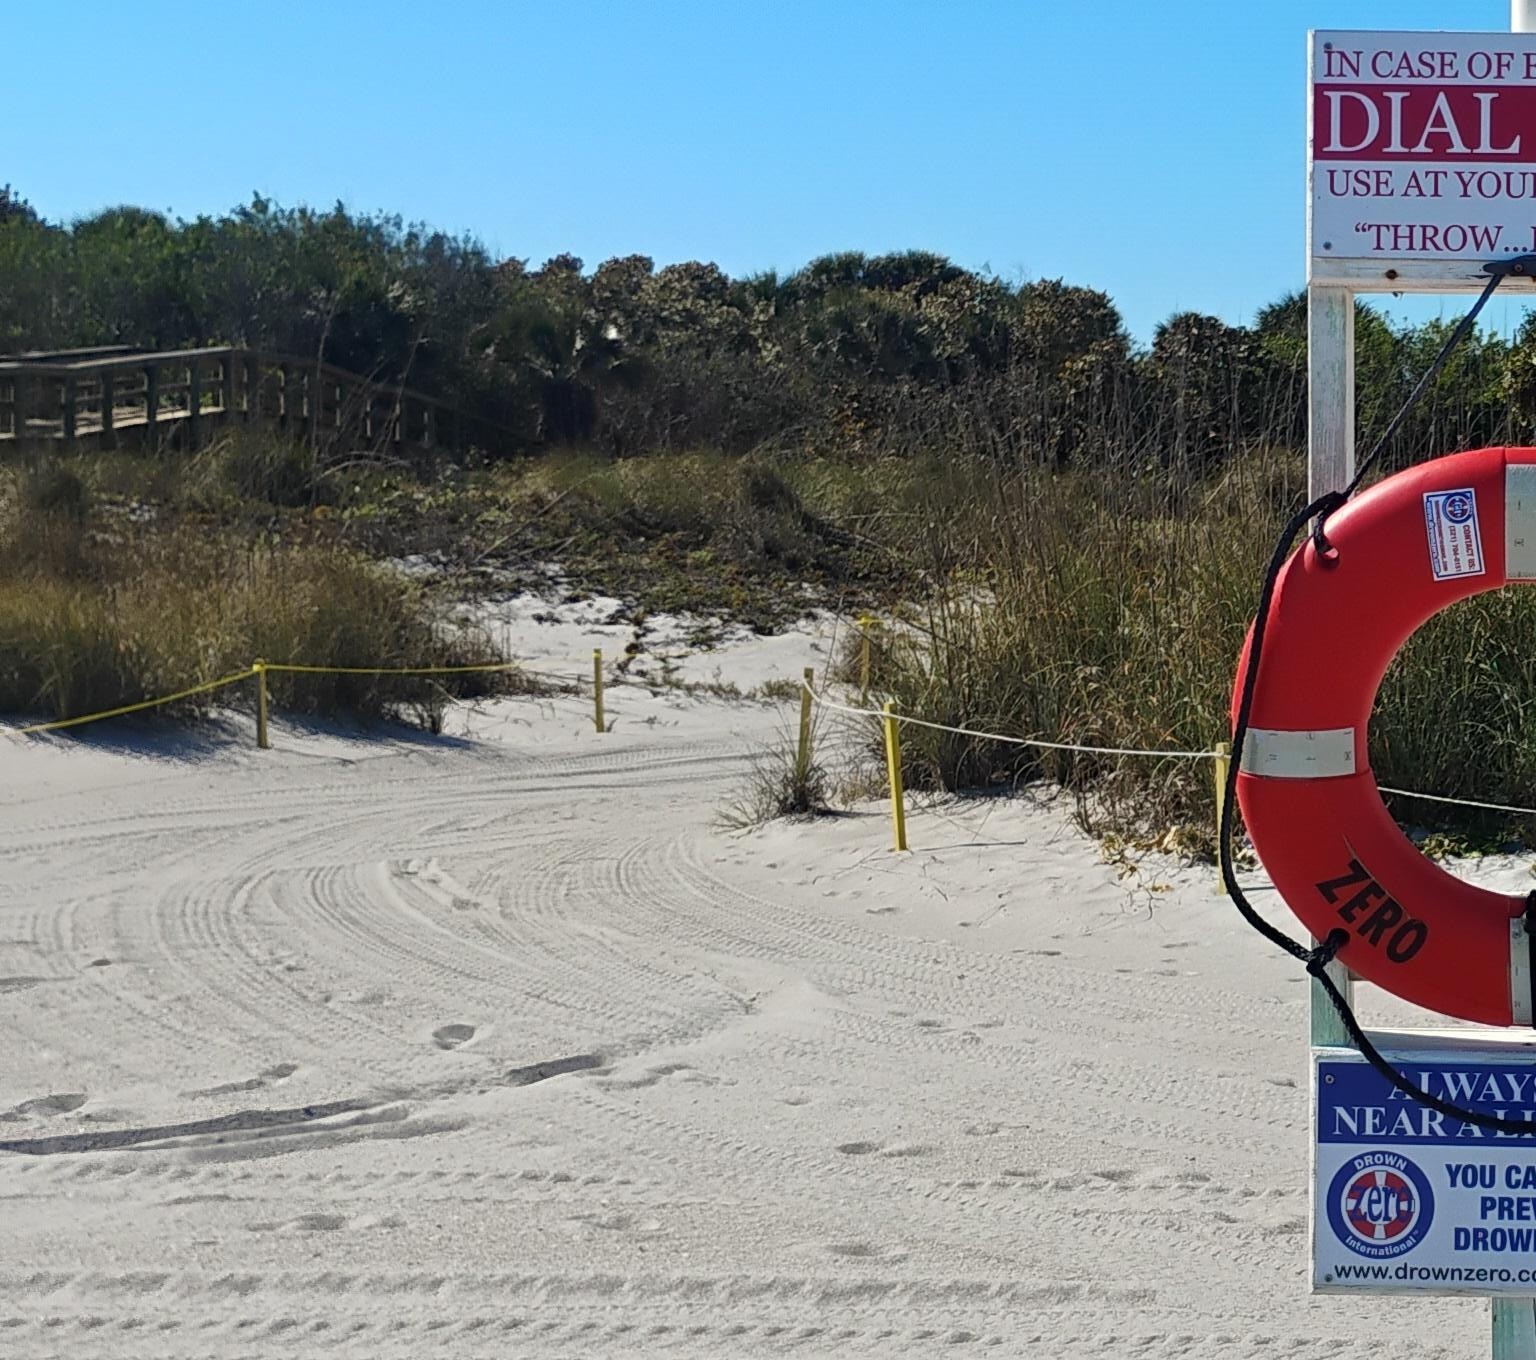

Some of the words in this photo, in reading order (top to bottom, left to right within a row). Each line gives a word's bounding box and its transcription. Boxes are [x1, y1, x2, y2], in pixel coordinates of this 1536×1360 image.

[1324, 51, 1363, 78] IN
[1371, 51, 1459, 79] CASE
[1467, 52, 1514, 80] OF
[1322, 90, 1521, 155] DIAL
[1328, 169, 1394, 197] USE
[1405, 170, 1448, 197] AT
[1463, 524, 1474, 557] CONTACT
[1316, 857, 1428, 964] ZERO
[1332, 1106, 1447, 1137] NEAR
[1456, 1108, 1485, 1138] A
[1353, 1154, 1407, 1171] DROWN
[1445, 1163, 1498, 1189] YOU
[1345, 1235, 1416, 1256] International
